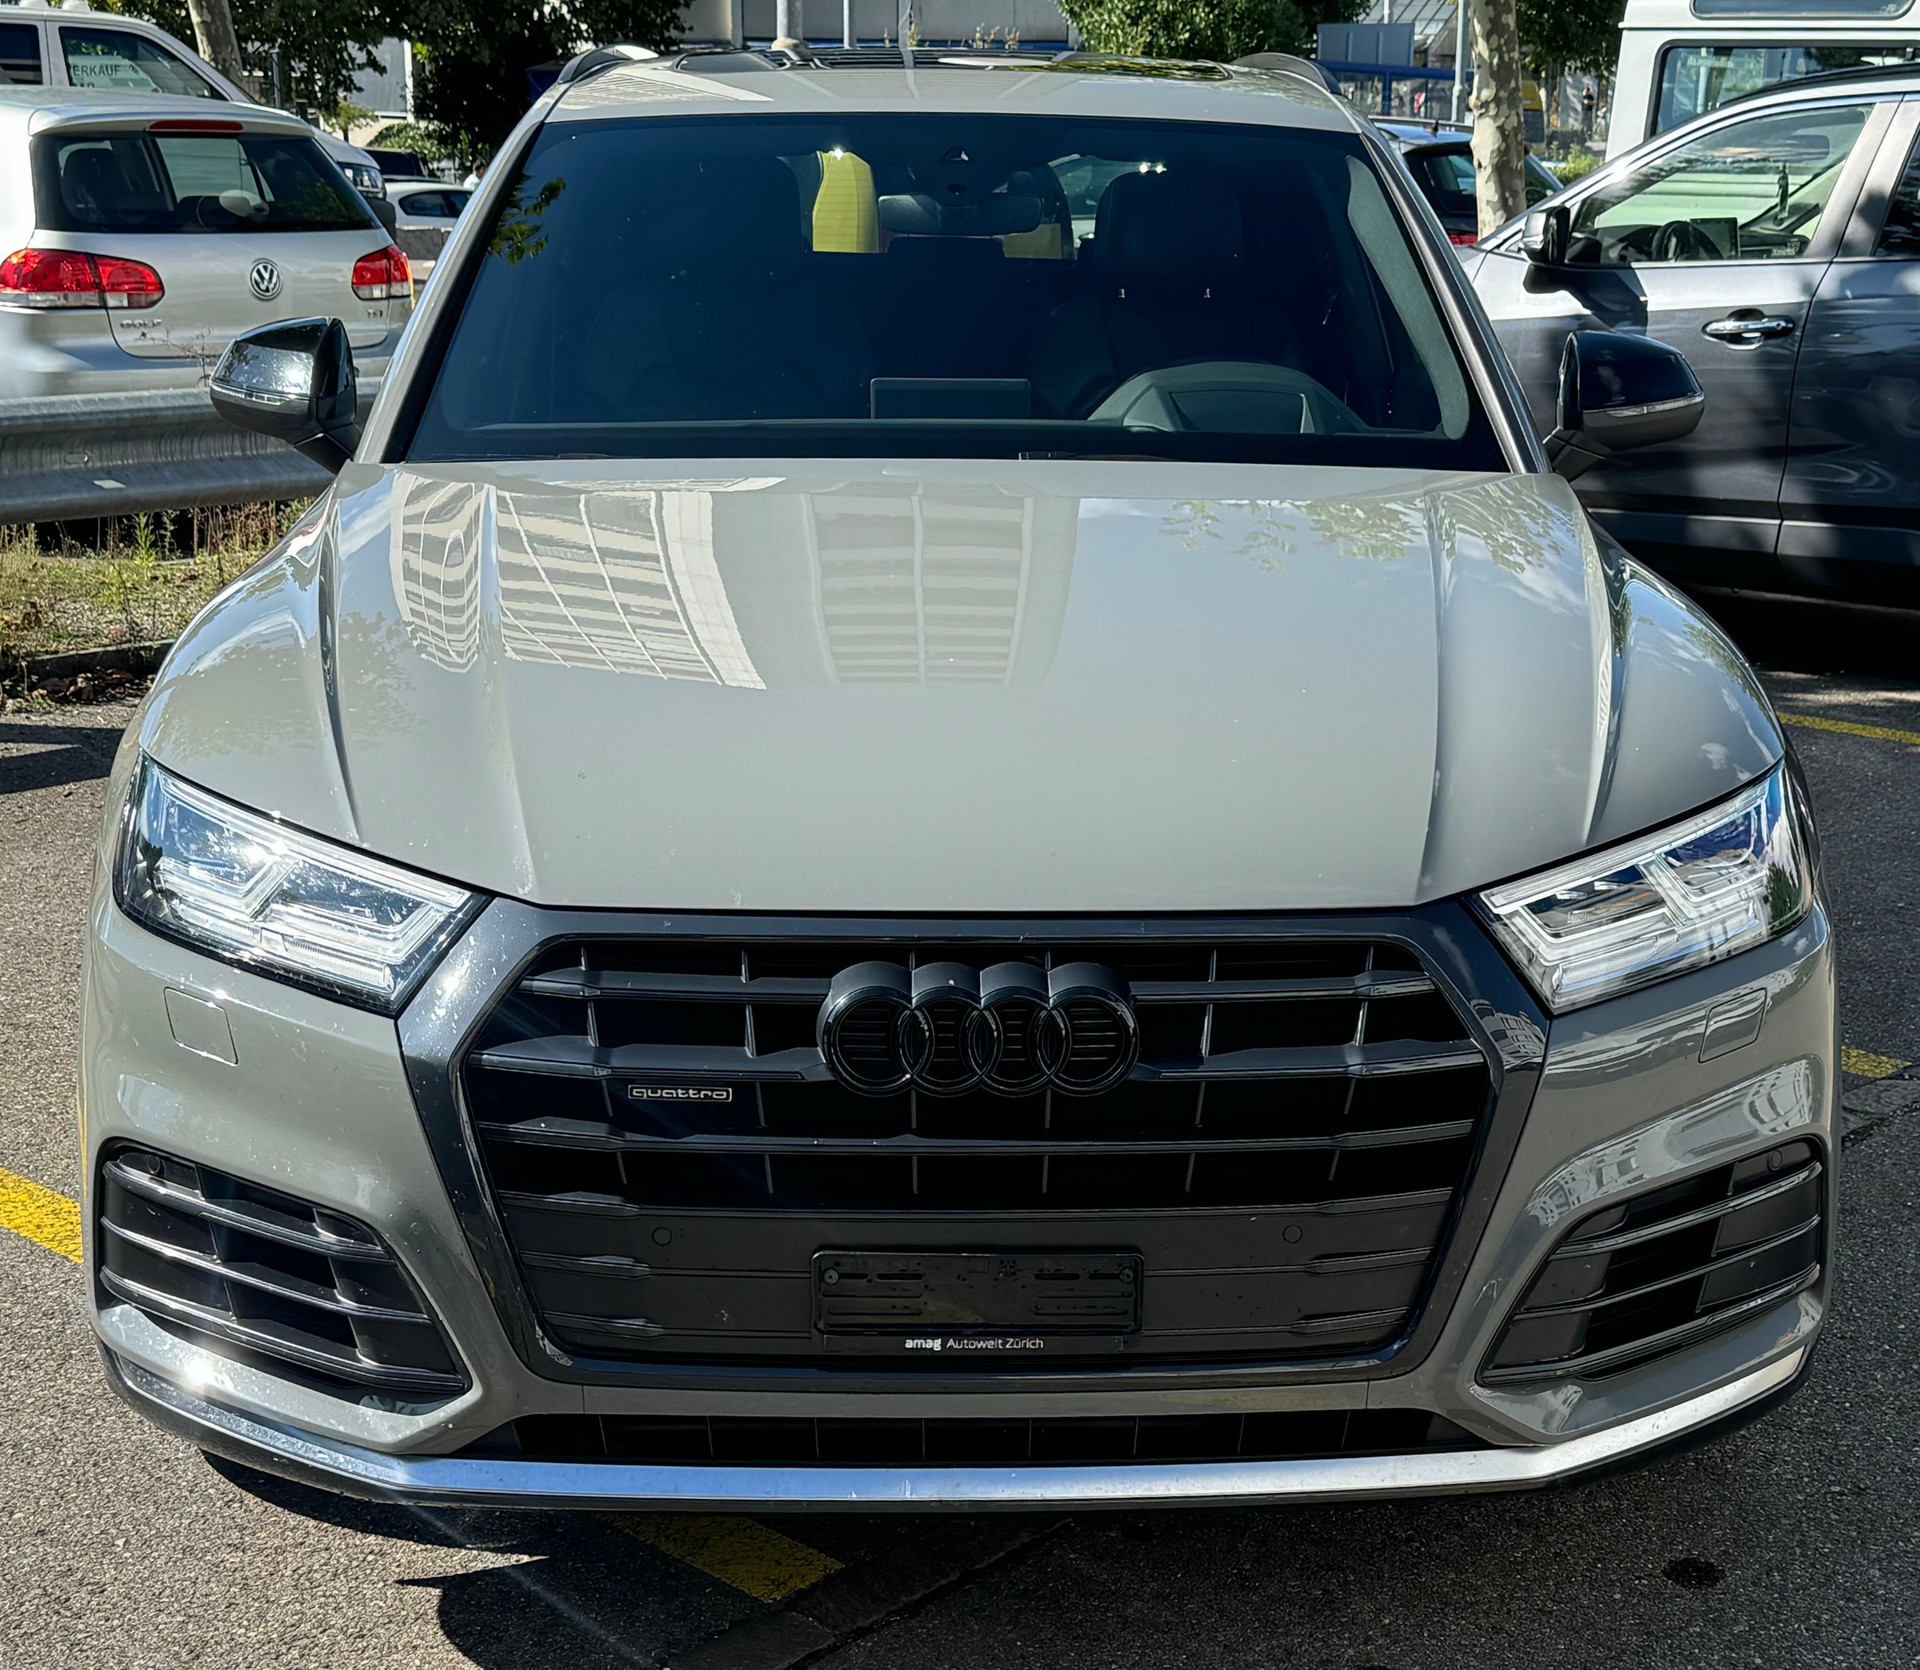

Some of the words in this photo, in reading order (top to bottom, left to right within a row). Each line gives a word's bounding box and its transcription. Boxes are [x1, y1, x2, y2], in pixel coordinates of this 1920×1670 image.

[120, 319, 162, 328] GOLF
[632, 1088, 727, 1099] quattro
[904, 1338, 942, 1351] amag
[946, 1338, 1003, 1349] Autowelt
[1005, 1338, 1044, 1349] Zürich
